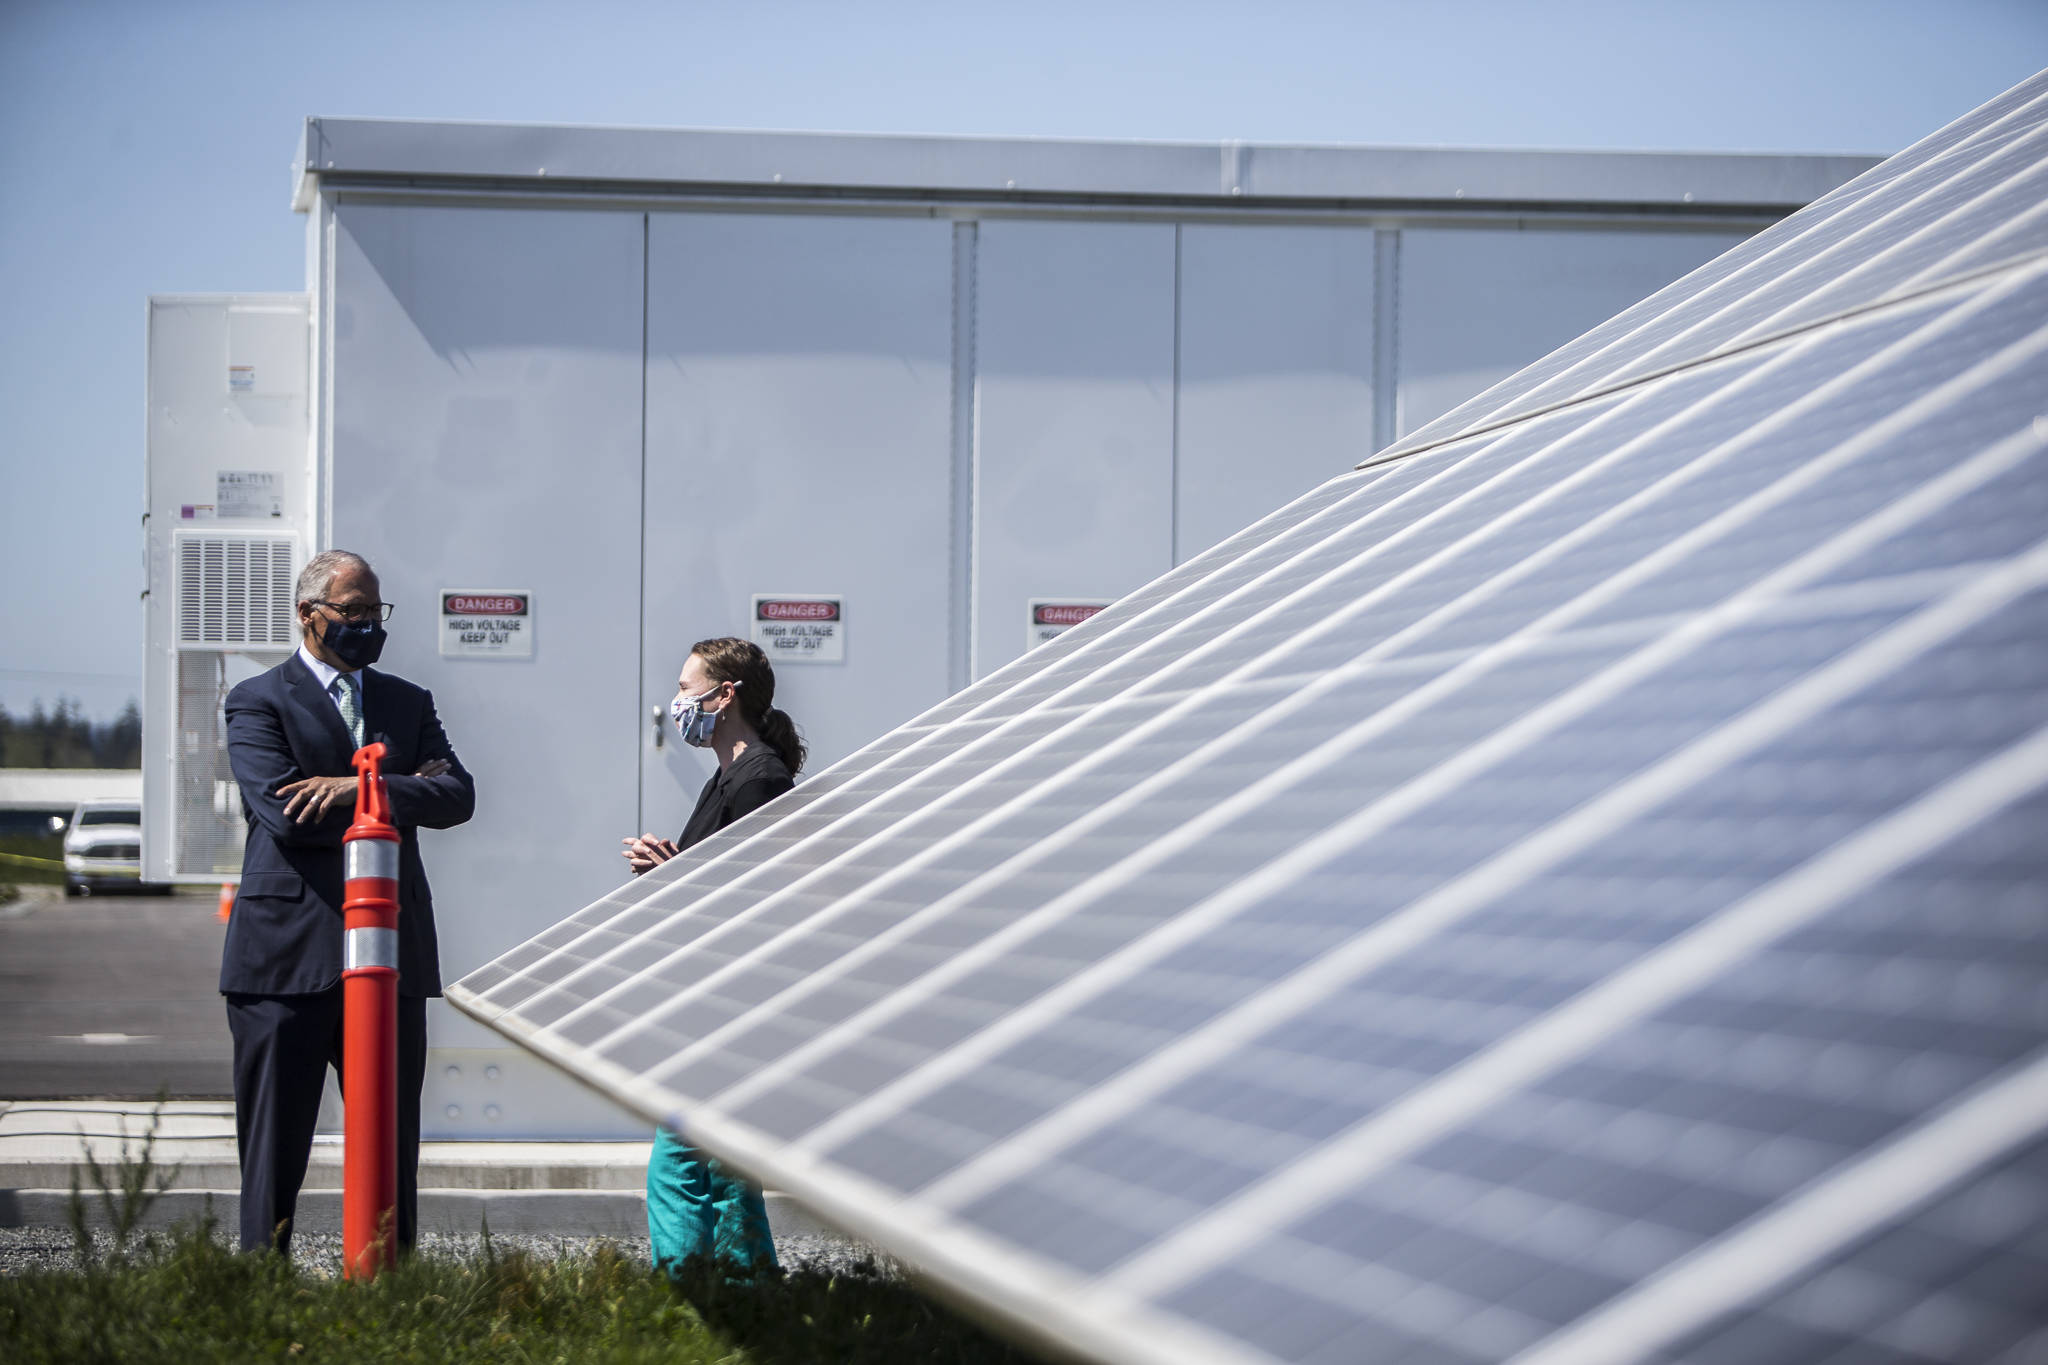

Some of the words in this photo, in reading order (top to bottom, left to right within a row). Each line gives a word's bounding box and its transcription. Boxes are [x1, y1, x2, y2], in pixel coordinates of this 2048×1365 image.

[455, 598, 515, 610] DANGER
[768, 604, 828, 616] DANGER
[448, 619, 474, 631] HIGH
[477, 619, 521, 631] VOLTAGE
[762, 625, 786, 637] HIGH
[791, 625, 833, 637] VOLTAGE
[460, 631, 486, 643] KEEP
[489, 631, 509, 643] OUT
[773, 637, 799, 649] KEEP
[803, 637, 823, 649] OUT
